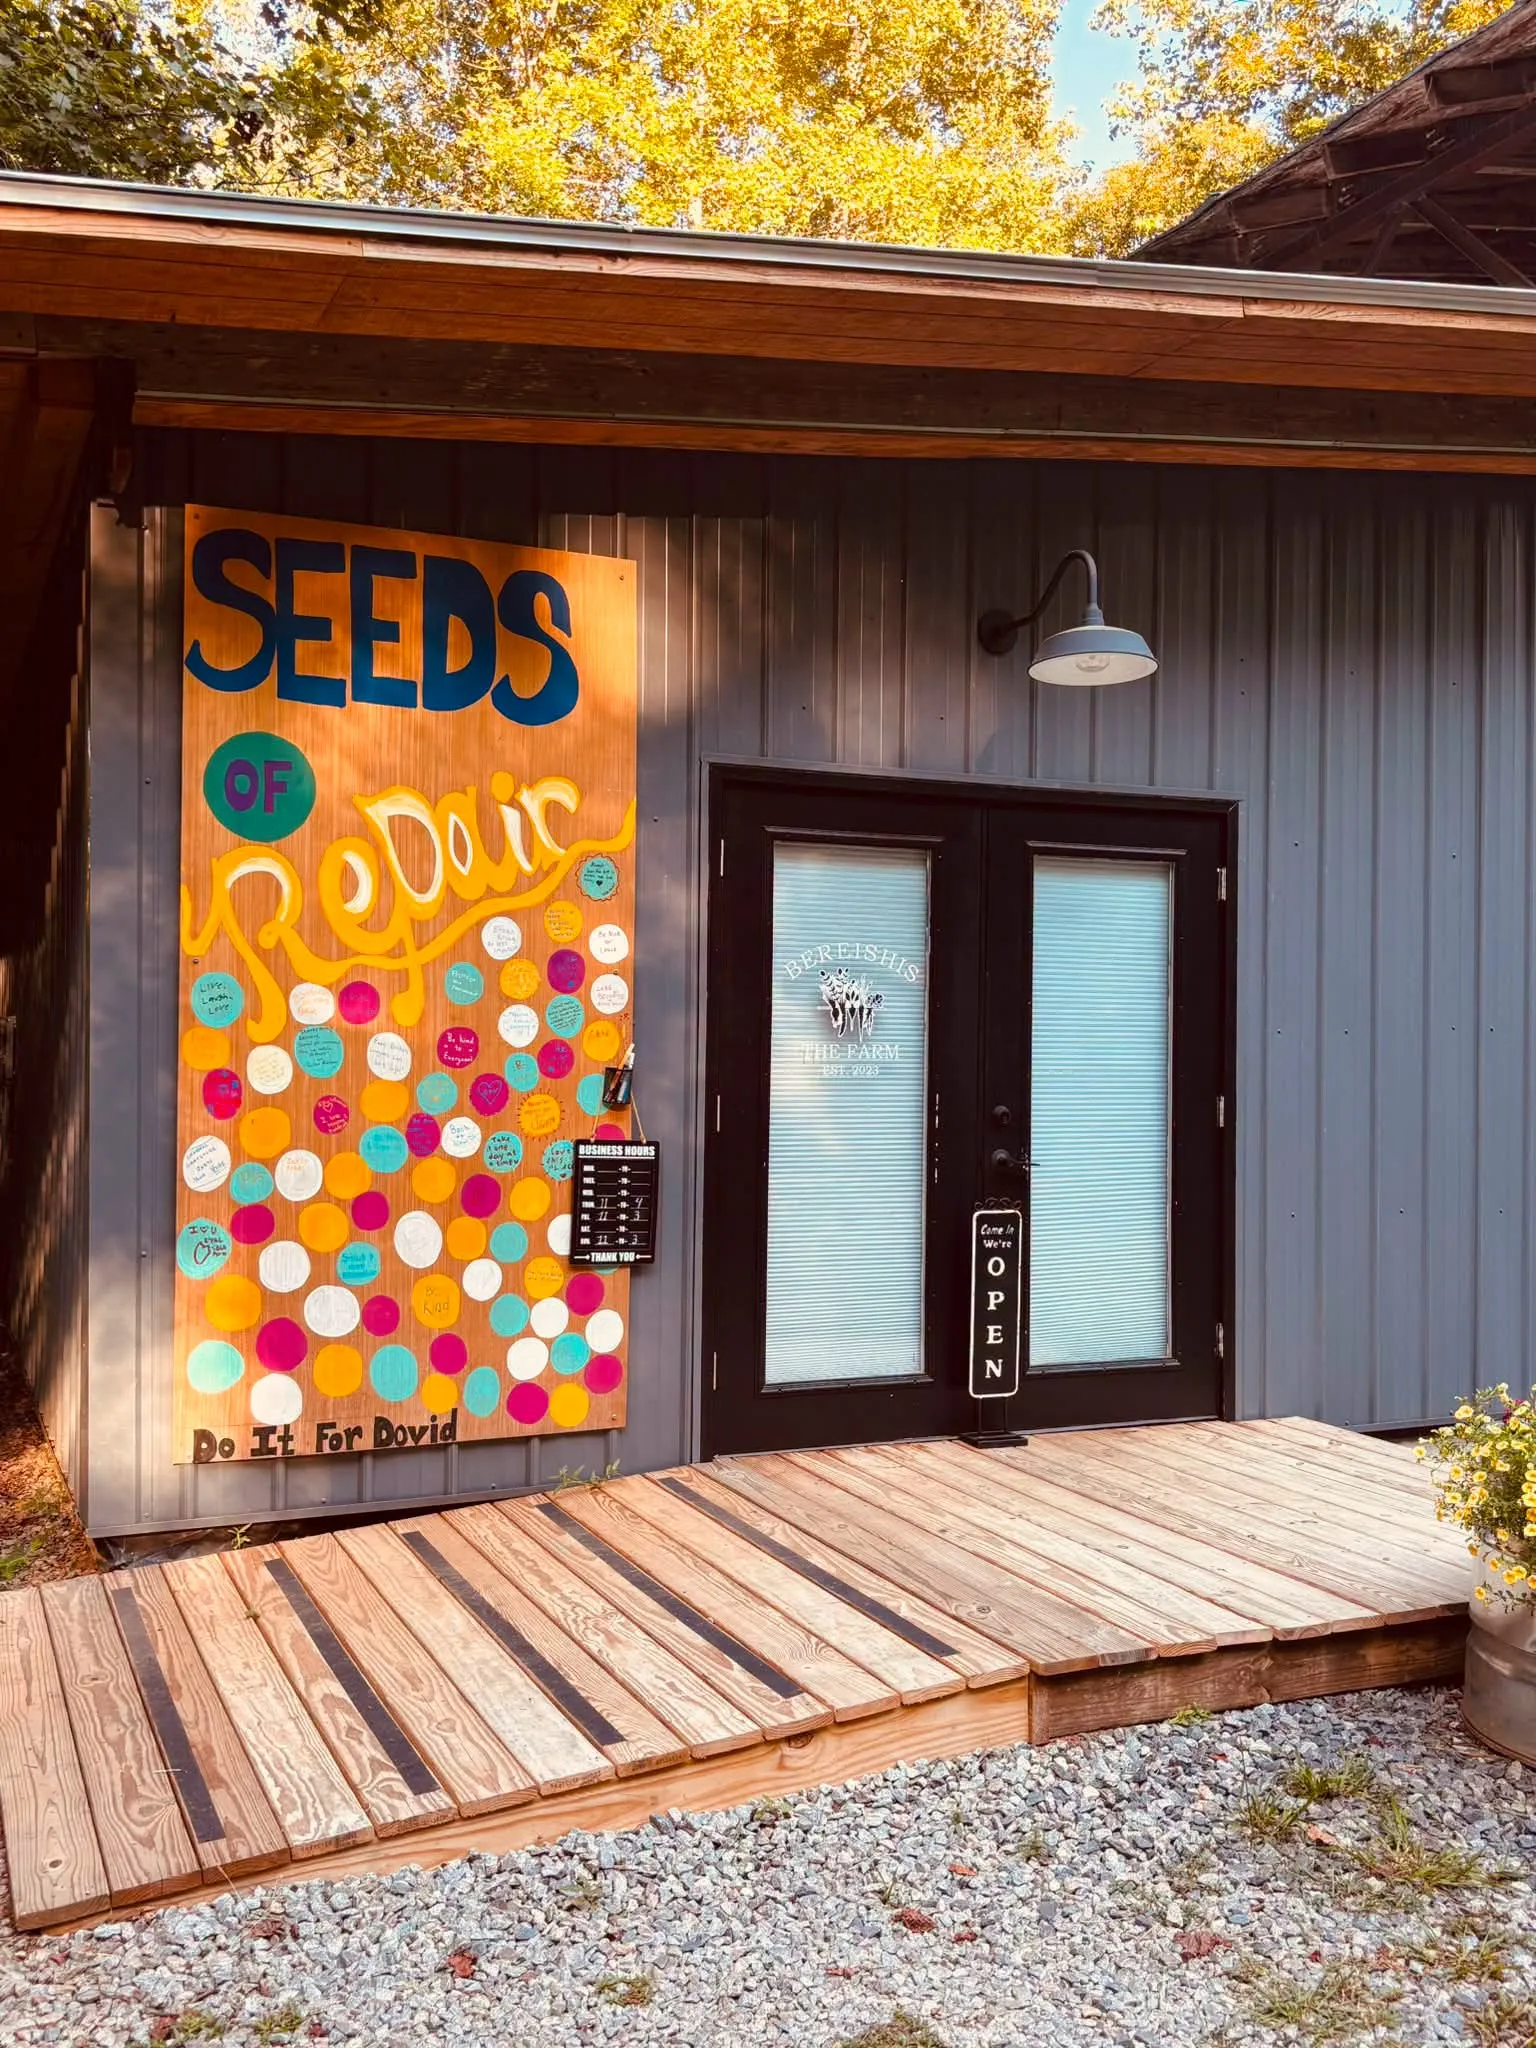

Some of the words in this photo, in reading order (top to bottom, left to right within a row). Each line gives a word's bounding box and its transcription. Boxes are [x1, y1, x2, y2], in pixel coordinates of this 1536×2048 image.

[185, 528, 579, 726] SEEDS
[224, 758, 293, 814] OF
[181, 771, 618, 1020] Repair
[784, 942, 919, 982] BEREISHIS
[801, 1044, 841, 1060] THE
[847, 1044, 900, 1061] FARM
[853, 1064, 880, 1076] 2023
[579, 1145, 623, 1156] BUSINESS
[624, 1145, 656, 1157] HOURS
[981, 1224, 1003, 1235] Come
[1005, 1224, 1015, 1235] In
[590, 1252, 618, 1262] THANK
[619, 1252, 636, 1262] YOU
[983, 1239, 1012, 1249] We're
[985, 1256, 1006, 1378] OPEN
[193, 1428, 236, 1464] Do
[250, 1424, 295, 1457] It
[315, 1422, 363, 1453] For
[373, 1408, 458, 1448] Dovid
